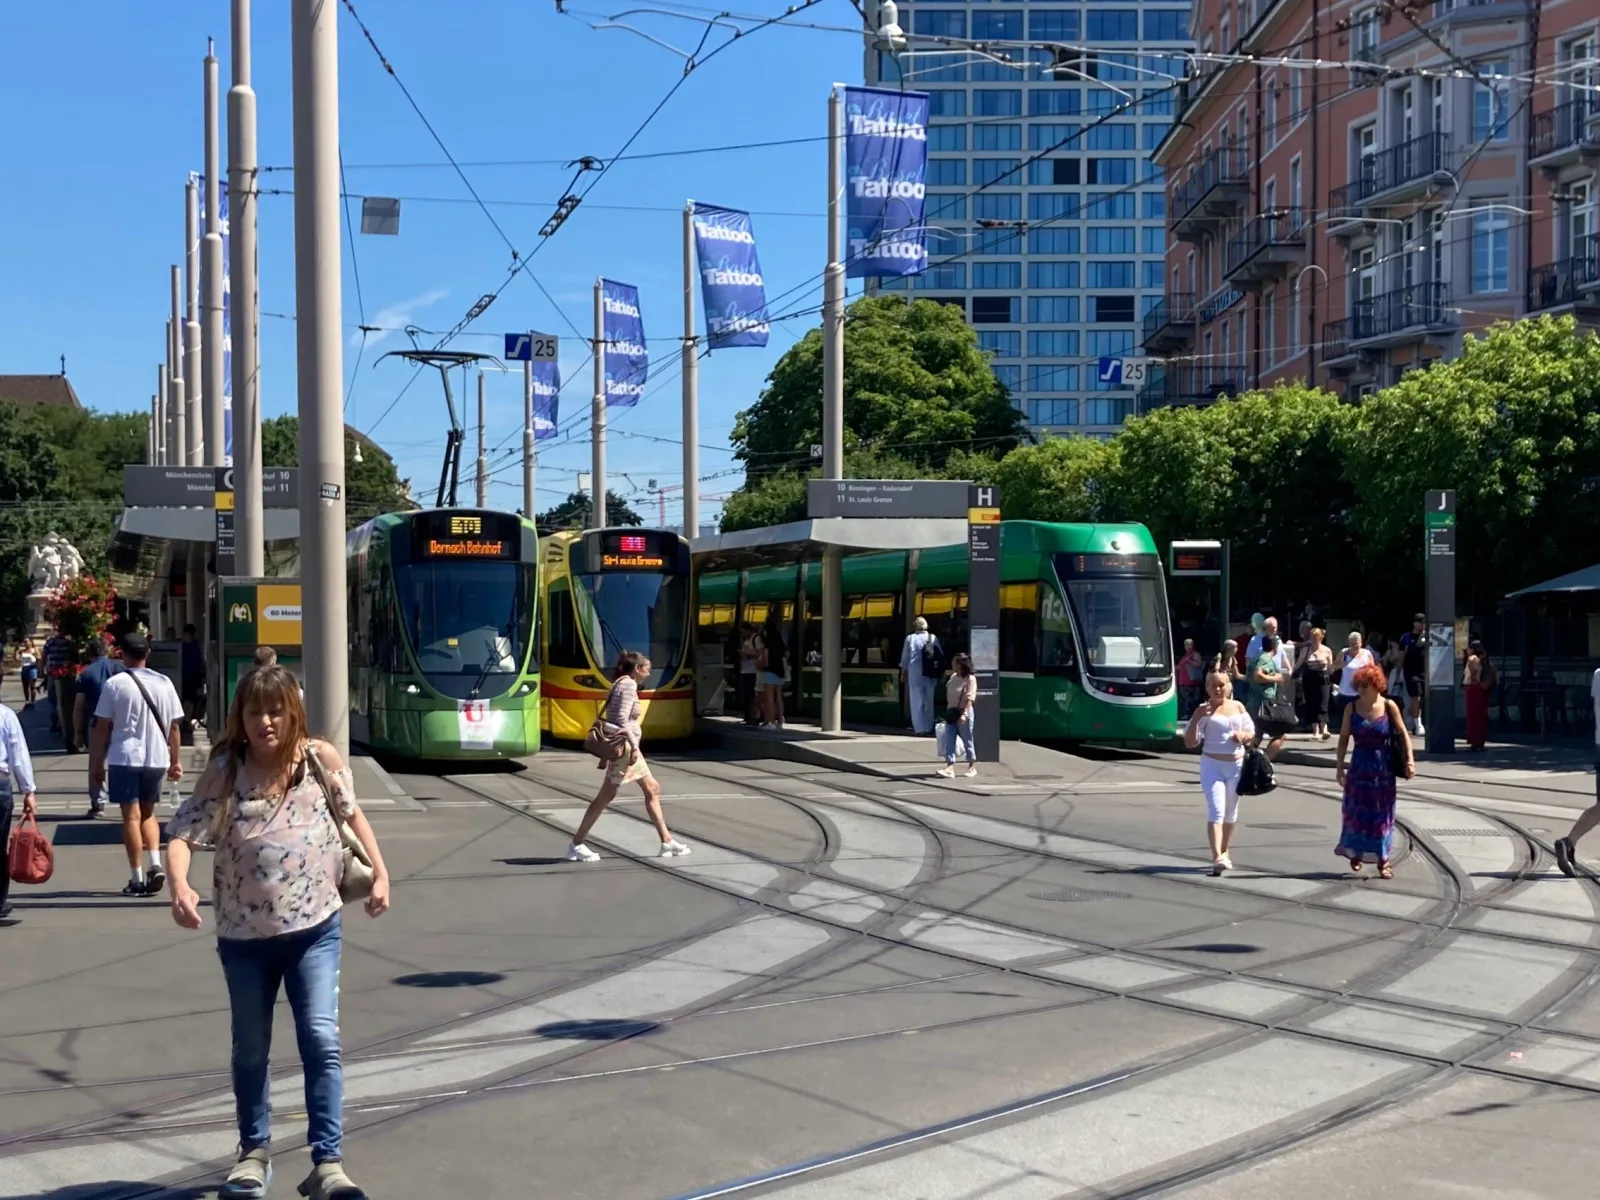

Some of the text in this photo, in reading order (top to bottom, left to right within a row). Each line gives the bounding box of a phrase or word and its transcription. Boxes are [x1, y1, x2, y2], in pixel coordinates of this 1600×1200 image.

[534, 339, 555, 357] 25
[1125, 363, 1143, 380] 25
[280, 471, 290, 480] 10
[280, 483, 289, 492] 11
[837, 483, 846, 492] 10
[837, 495, 845, 503] 11
[977, 487, 993, 506] H
[1438, 492, 1446, 511] J
